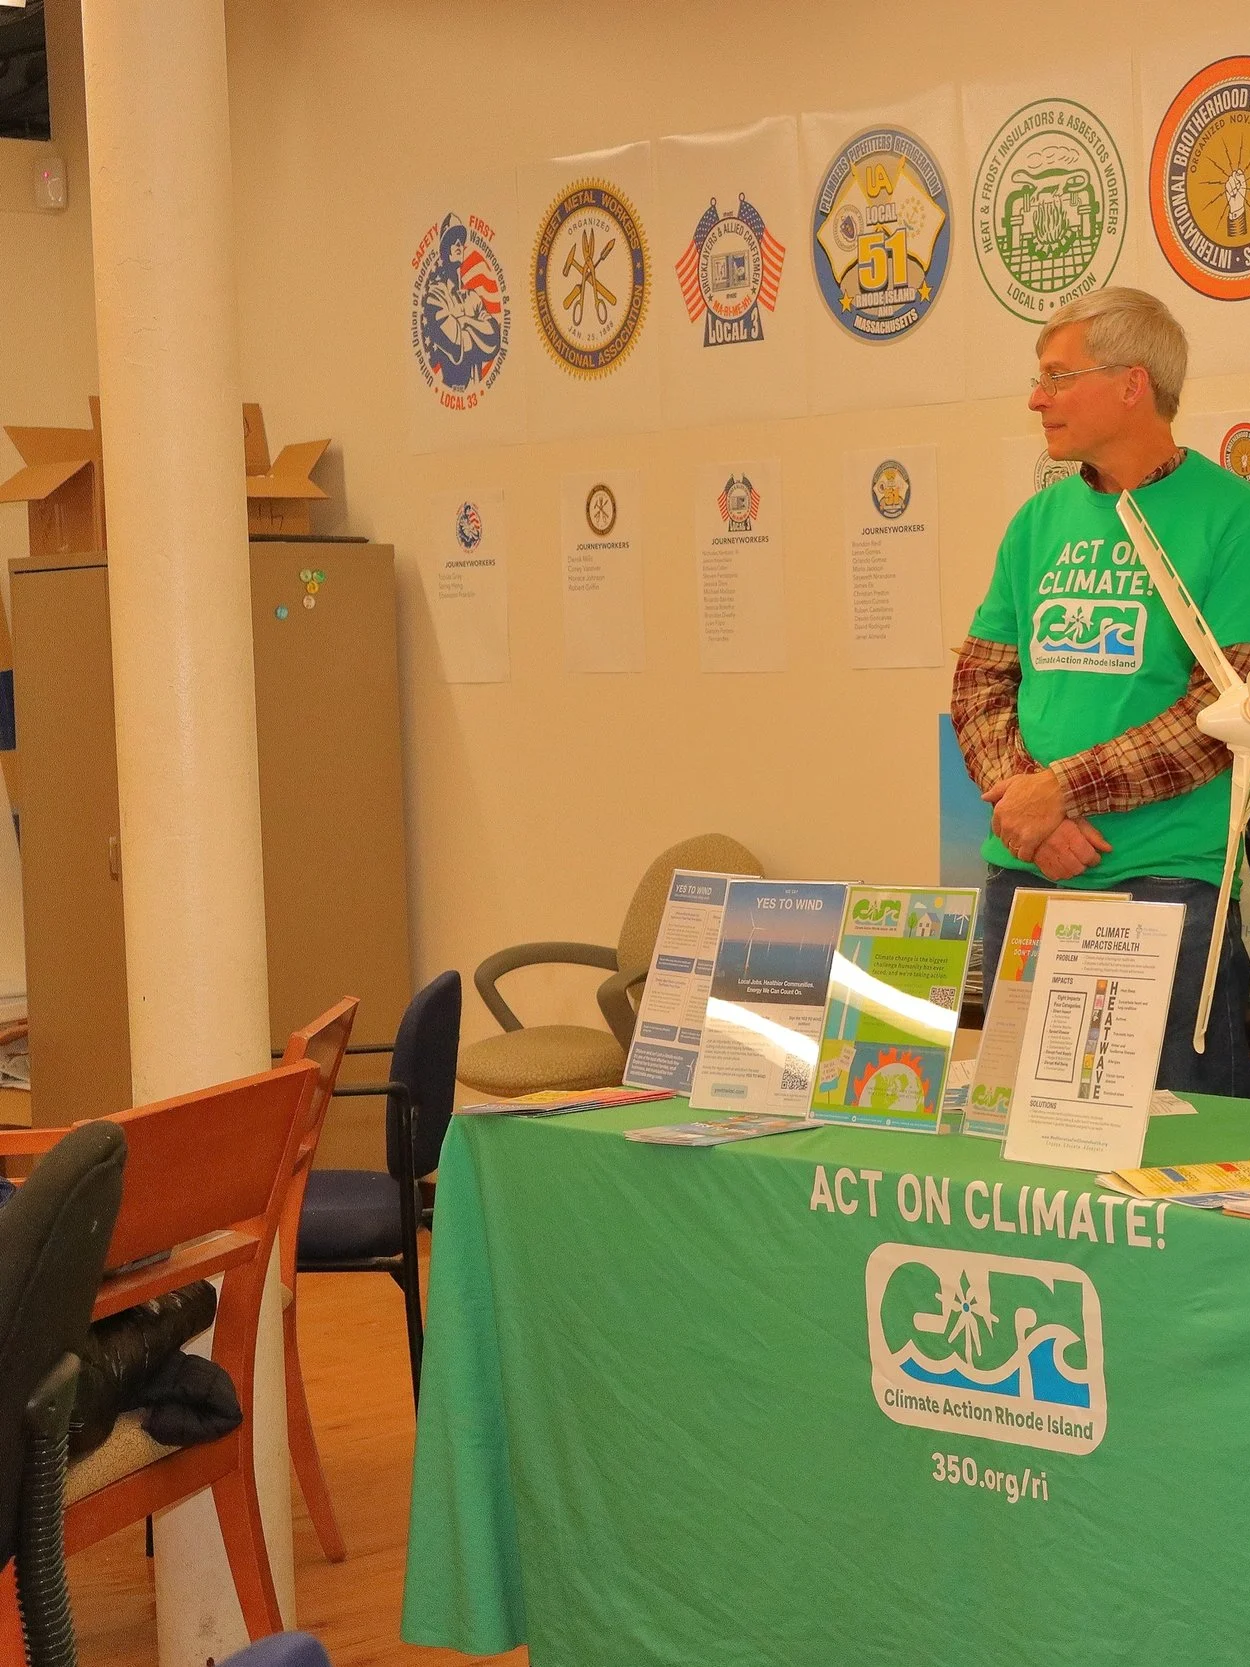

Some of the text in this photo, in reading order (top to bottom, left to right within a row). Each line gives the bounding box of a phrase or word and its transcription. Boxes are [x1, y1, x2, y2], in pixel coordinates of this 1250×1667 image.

[1172, 88, 1248, 168] BROTHERHOOD
[1190, 119, 1226, 174] ORGANIZED
[1229, 114, 1250, 125] NOV.
[820, 134, 942, 214] PLUMBERS PIPEFITTERS REFRIGERATION
[866, 164, 894, 198] UA
[980, 111, 1120, 254] HEAT & FROST INSULATORS & ASBESTOS WORKERS
[540, 210, 562, 257] SHEET
[563, 190, 596, 214] METAL
[567, 218, 611, 236] ORGANIZED
[866, 202, 898, 226] LOCAL
[1170, 172, 1232, 270] INTERNATIONAL
[411, 215, 496, 270] SAFETY FIRST
[700, 223, 762, 294] BRICKLAYERS ALLIED CRAFTSMEN
[857, 229, 909, 291] 51
[855, 287, 917, 308] RHODE ISLAND
[1006, 272, 1098, 312] LOCAL 6 BOSTON
[412, 230, 508, 390] United Union Roofers, Waterproofers Workers
[854, 308, 919, 334] MASSACHUSETTS
[878, 306, 894, 317] AND
[536, 284, 644, 368] INTERNATIONAL ASSOCIATION
[708, 306, 759, 344] LOCAL 3
[439, 390, 479, 411] LOCAL 33
[711, 536, 770, 546] JOURNEYWORKERS
[861, 524, 925, 536] JOURNEYWORKERS
[576, 542, 630, 551] JOURNEYWORKERS
[1056, 539, 1105, 566] ACT
[445, 558, 496, 568] JOURNEYWORKERS
[1038, 569, 1155, 596] CLIMATE!
[1036, 656, 1136, 668] Climate Action Rhode Island
[675, 884, 712, 896] YES WIND
[756, 898, 824, 911] YES TO WIND
[1096, 926, 1130, 938] CLIMATE
[1056, 954, 1078, 962] PROBLEM
[1082, 940, 1140, 952] IMPACTS HEALTH
[1052, 976, 1074, 984] IMPACTS
[1030, 1100, 1058, 1110] SOLUTIONS
[810, 1165, 1171, 1250] ACT ON CLIMATE!
[884, 1388, 1094, 1441] Climate Action Rhode Island
[931, 1452, 1049, 1504] 350.org/ri
